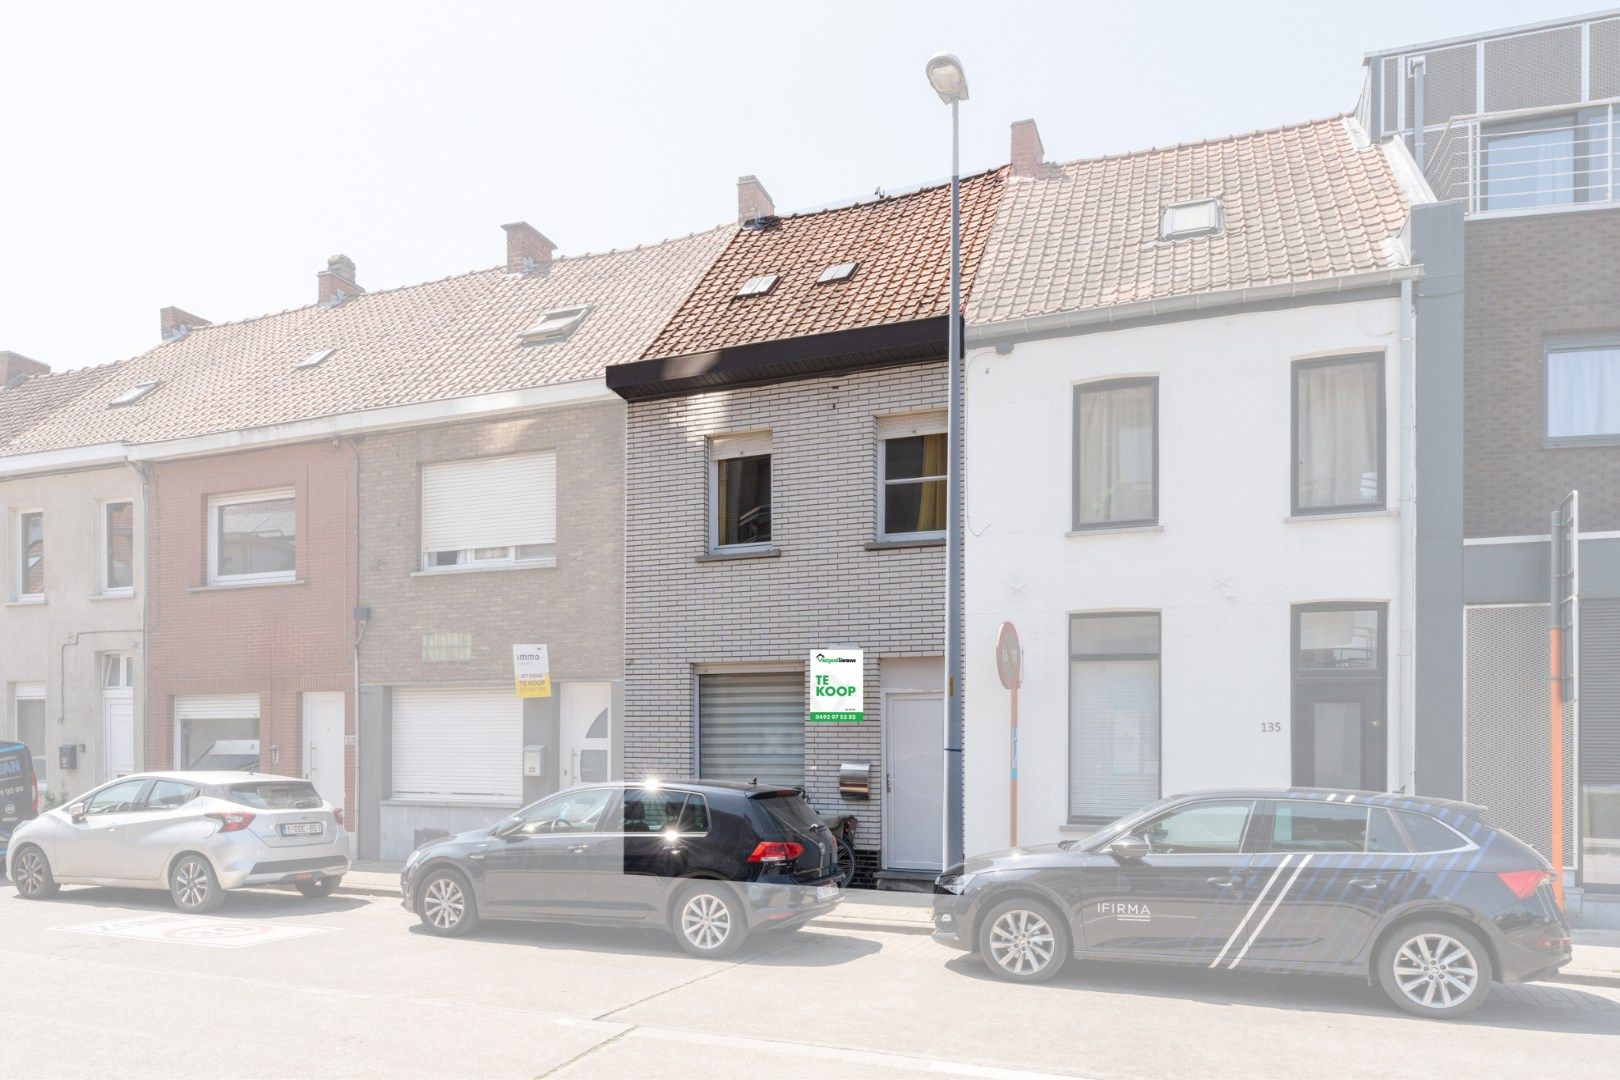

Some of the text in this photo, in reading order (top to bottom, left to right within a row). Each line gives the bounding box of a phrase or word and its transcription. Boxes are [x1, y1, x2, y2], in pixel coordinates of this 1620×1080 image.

[528, 679, 546, 687] KOOP
[816, 675, 829, 685] TE
[816, 686, 856, 697] KOOP
[1261, 722, 1282, 733] 135
[1097, 902, 1151, 915] IFIRMA
